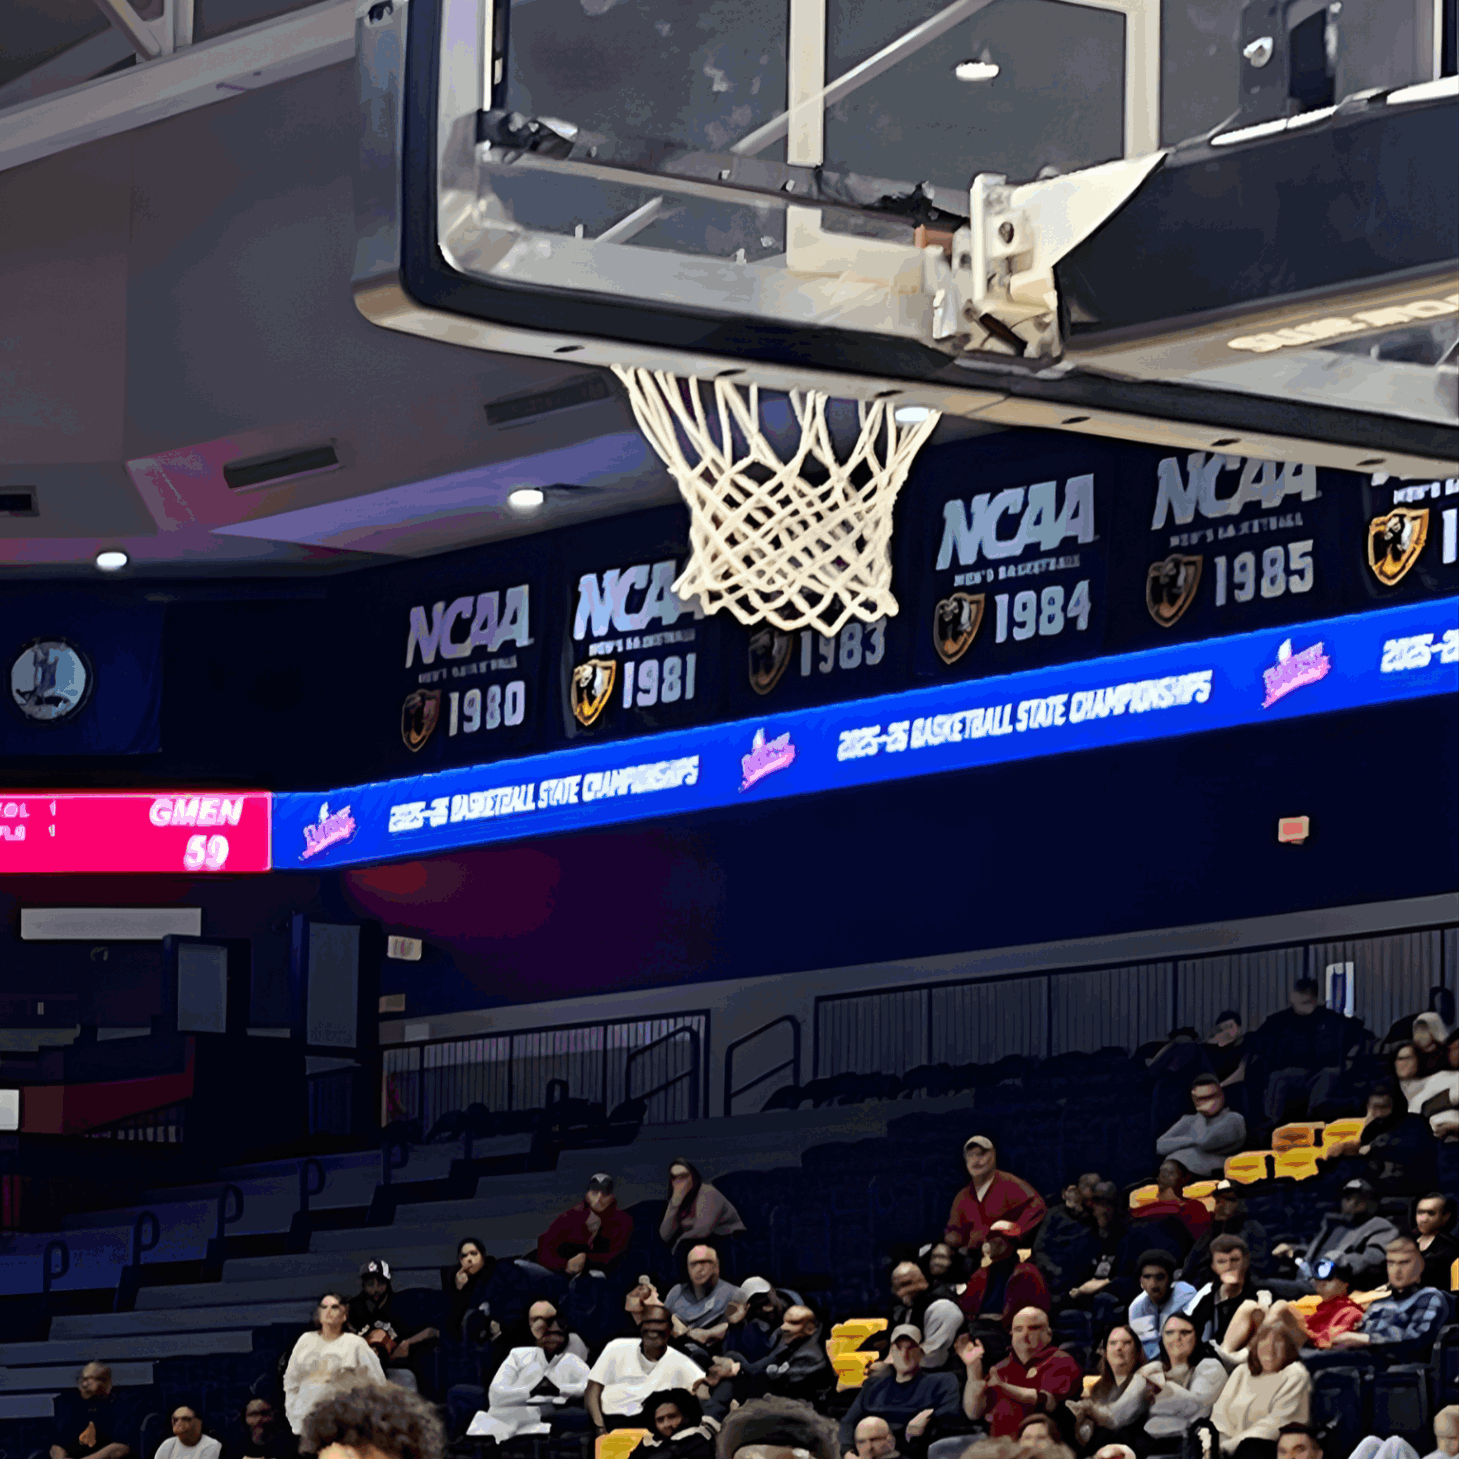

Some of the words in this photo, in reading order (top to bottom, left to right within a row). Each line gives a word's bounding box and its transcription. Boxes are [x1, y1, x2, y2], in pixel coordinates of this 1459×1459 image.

[936, 473, 1100, 571] NCAA
[1151, 452, 1322, 530] NCAA
[1215, 540, 1314, 607] 1985
[405, 584, 534, 669] NCAA
[994, 580, 1090, 643] 1984
[800, 616, 887, 677] 1983
[448, 680, 525, 737] 1980
[622, 653, 697, 709] 1981
[149, 797, 244, 827] GMEN
[183, 834, 230, 871] 59
